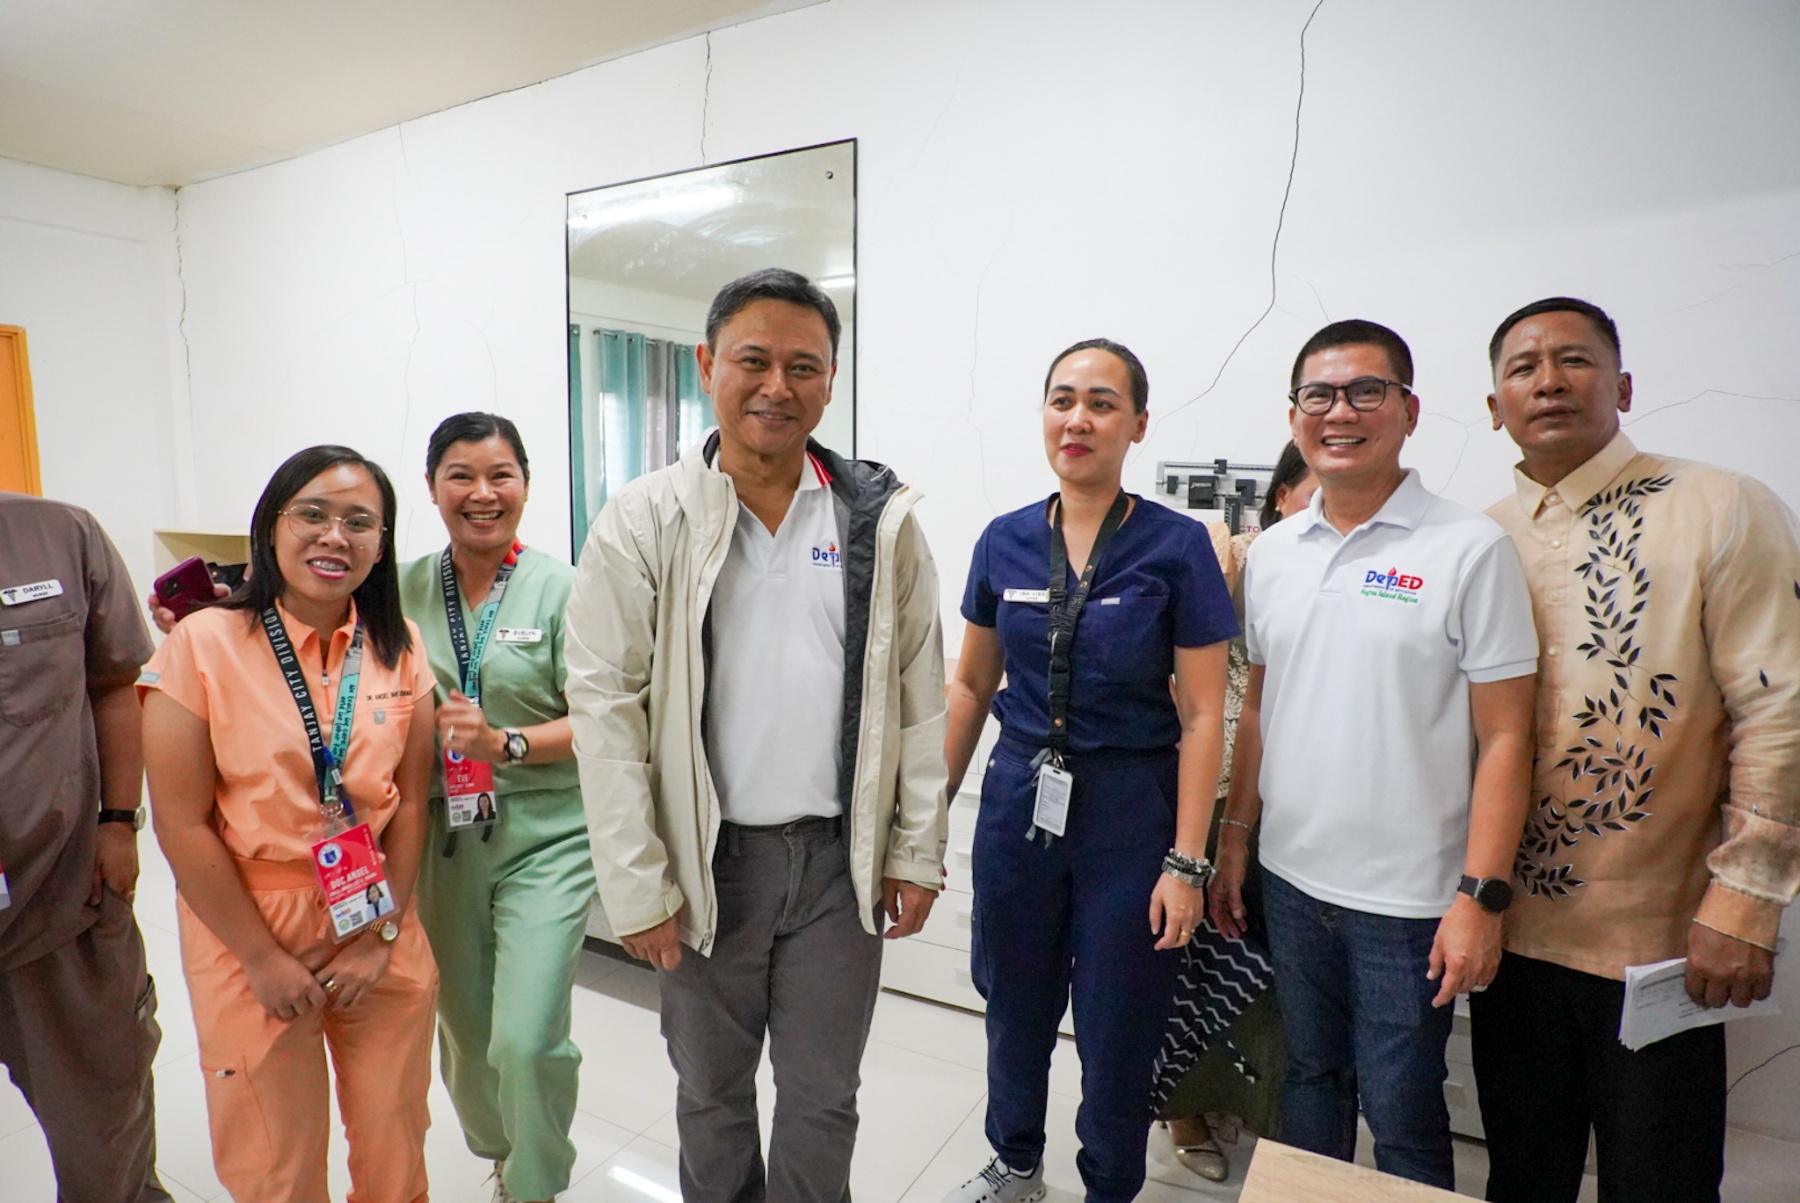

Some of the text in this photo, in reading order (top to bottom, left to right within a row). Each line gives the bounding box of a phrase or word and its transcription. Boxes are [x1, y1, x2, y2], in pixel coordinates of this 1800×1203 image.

[812, 547, 842, 568] Dep
[441, 552, 456, 596] DIVISION
[1365, 569, 1423, 590] DepED
[23, 583, 53, 593] DARYLL
[1378, 590, 1396, 599] Island
[1397, 593, 1418, 603] Region
[263, 607, 323, 753] TANJAY CITY DIVISION
[457, 774, 469, 782] EVE
